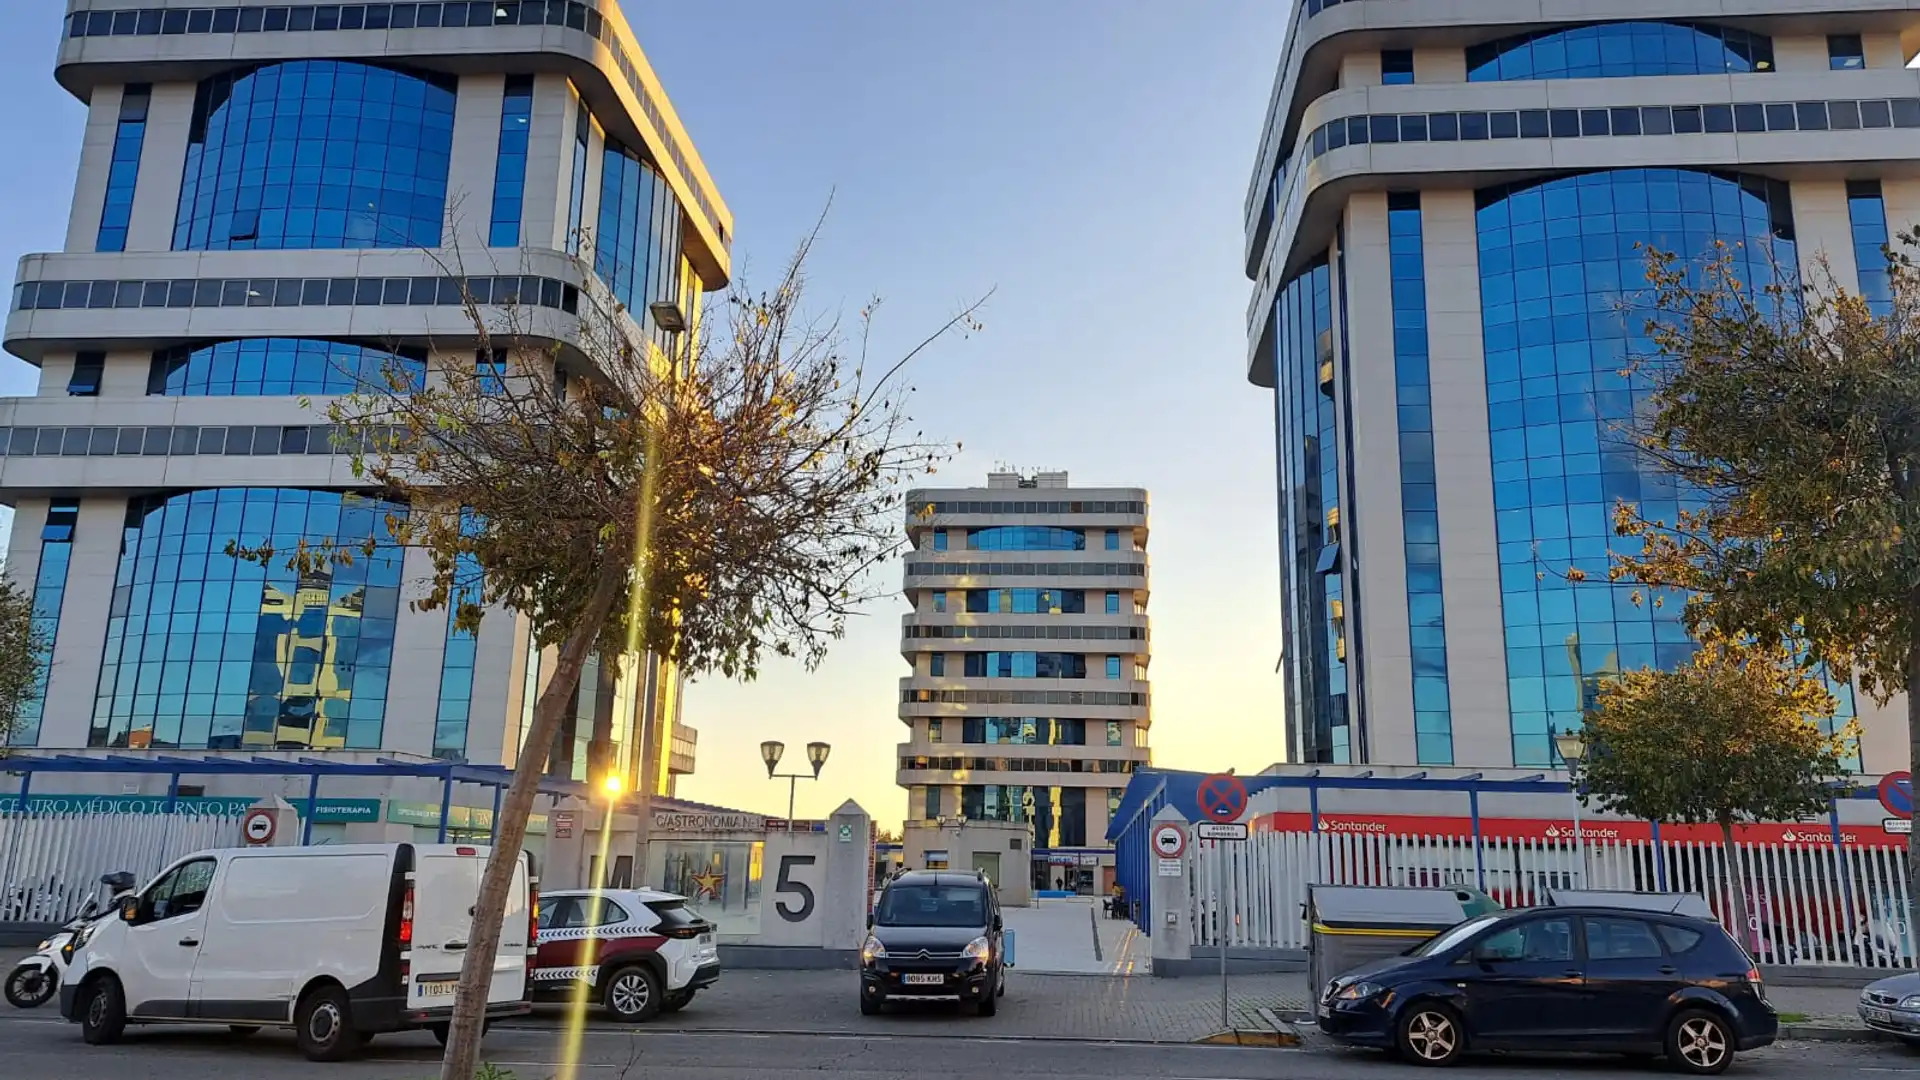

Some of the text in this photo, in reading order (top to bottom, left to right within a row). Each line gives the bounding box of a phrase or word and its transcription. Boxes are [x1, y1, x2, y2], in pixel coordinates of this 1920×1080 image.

[73, 797, 146, 814] MÉDICO
[315, 806, 371, 814] FISIOTERAPIA
[1331, 820, 1387, 832] Santander
[1561, 826, 1618, 838] Satander
[776, 855, 815, 922] 5
